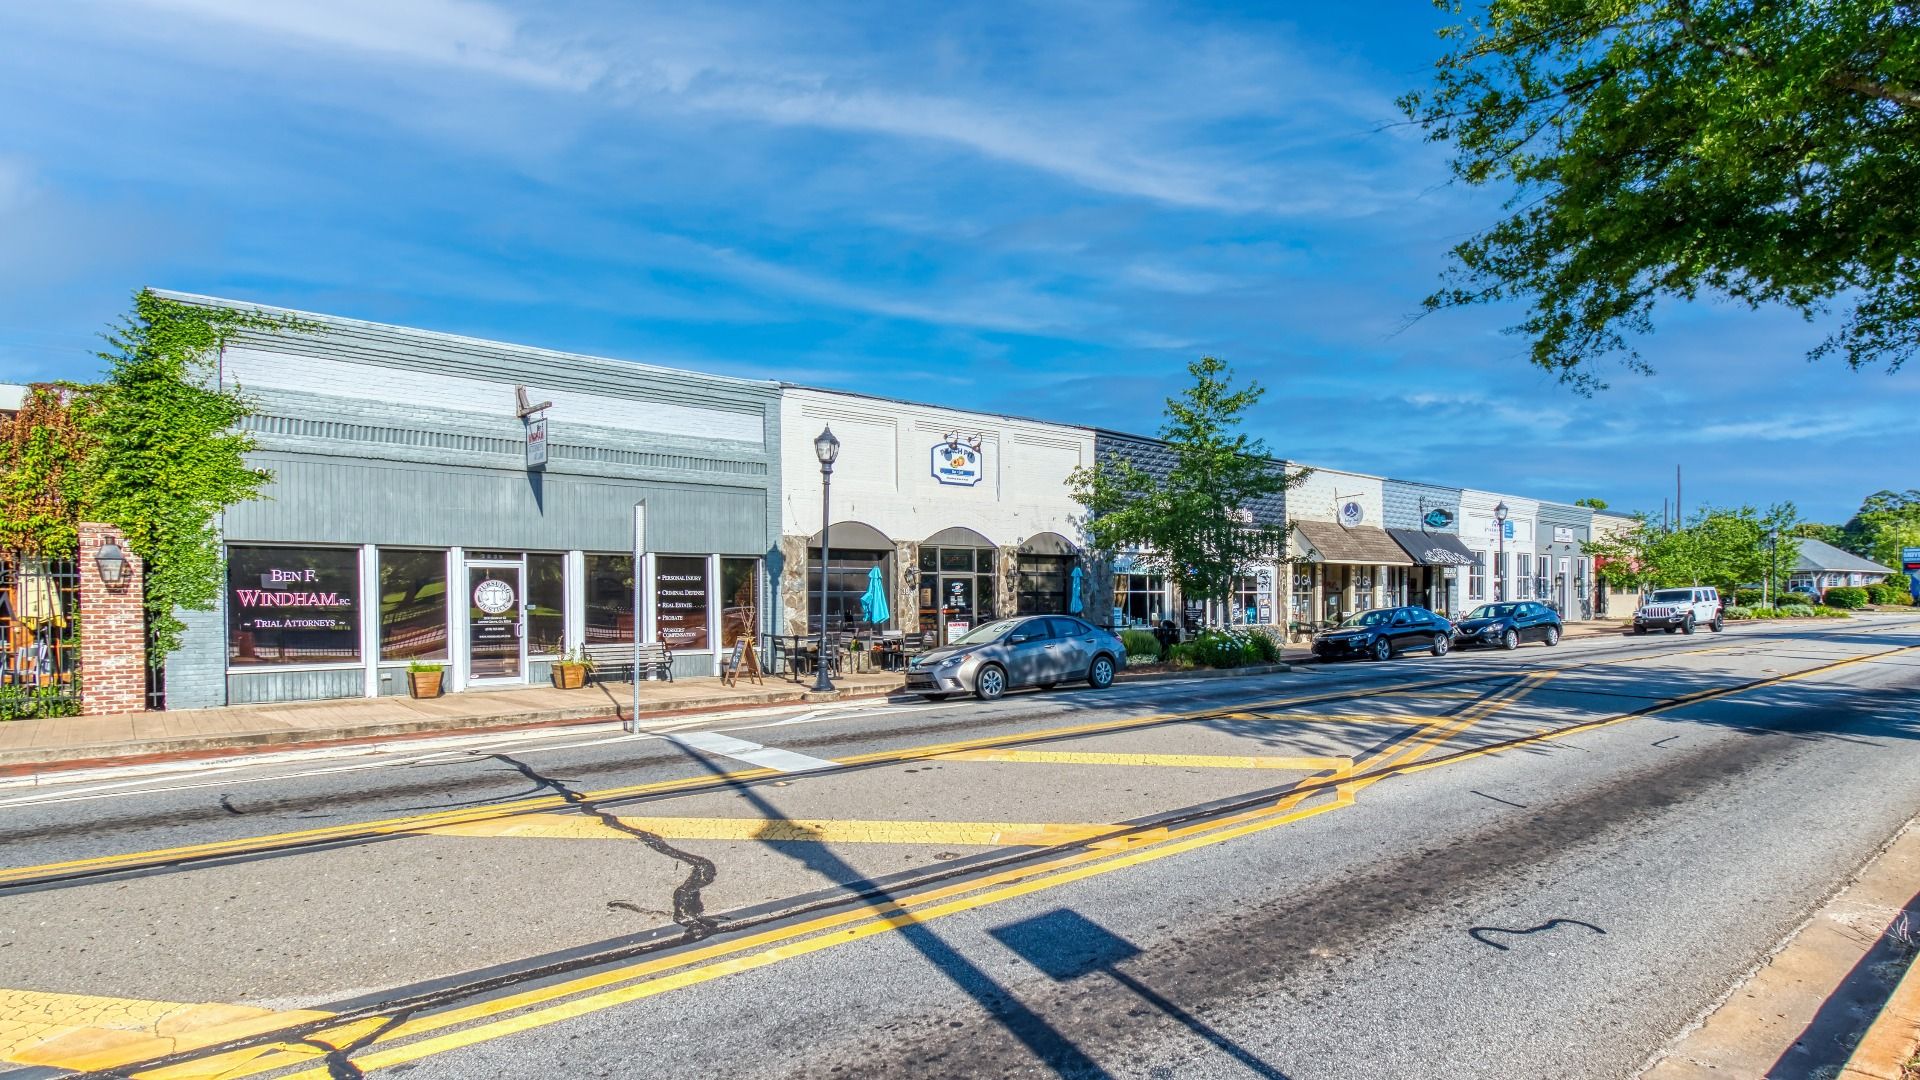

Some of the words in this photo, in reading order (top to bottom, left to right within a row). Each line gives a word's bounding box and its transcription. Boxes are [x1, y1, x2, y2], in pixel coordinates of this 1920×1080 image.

[1355, 575, 1372, 587] OGA
[479, 581, 512, 593] PURSUING
[480, 603, 509, 613] JUSTICE
[254, 619, 283, 628] TRIAL
[284, 619, 336, 628] ATTORNEYS
